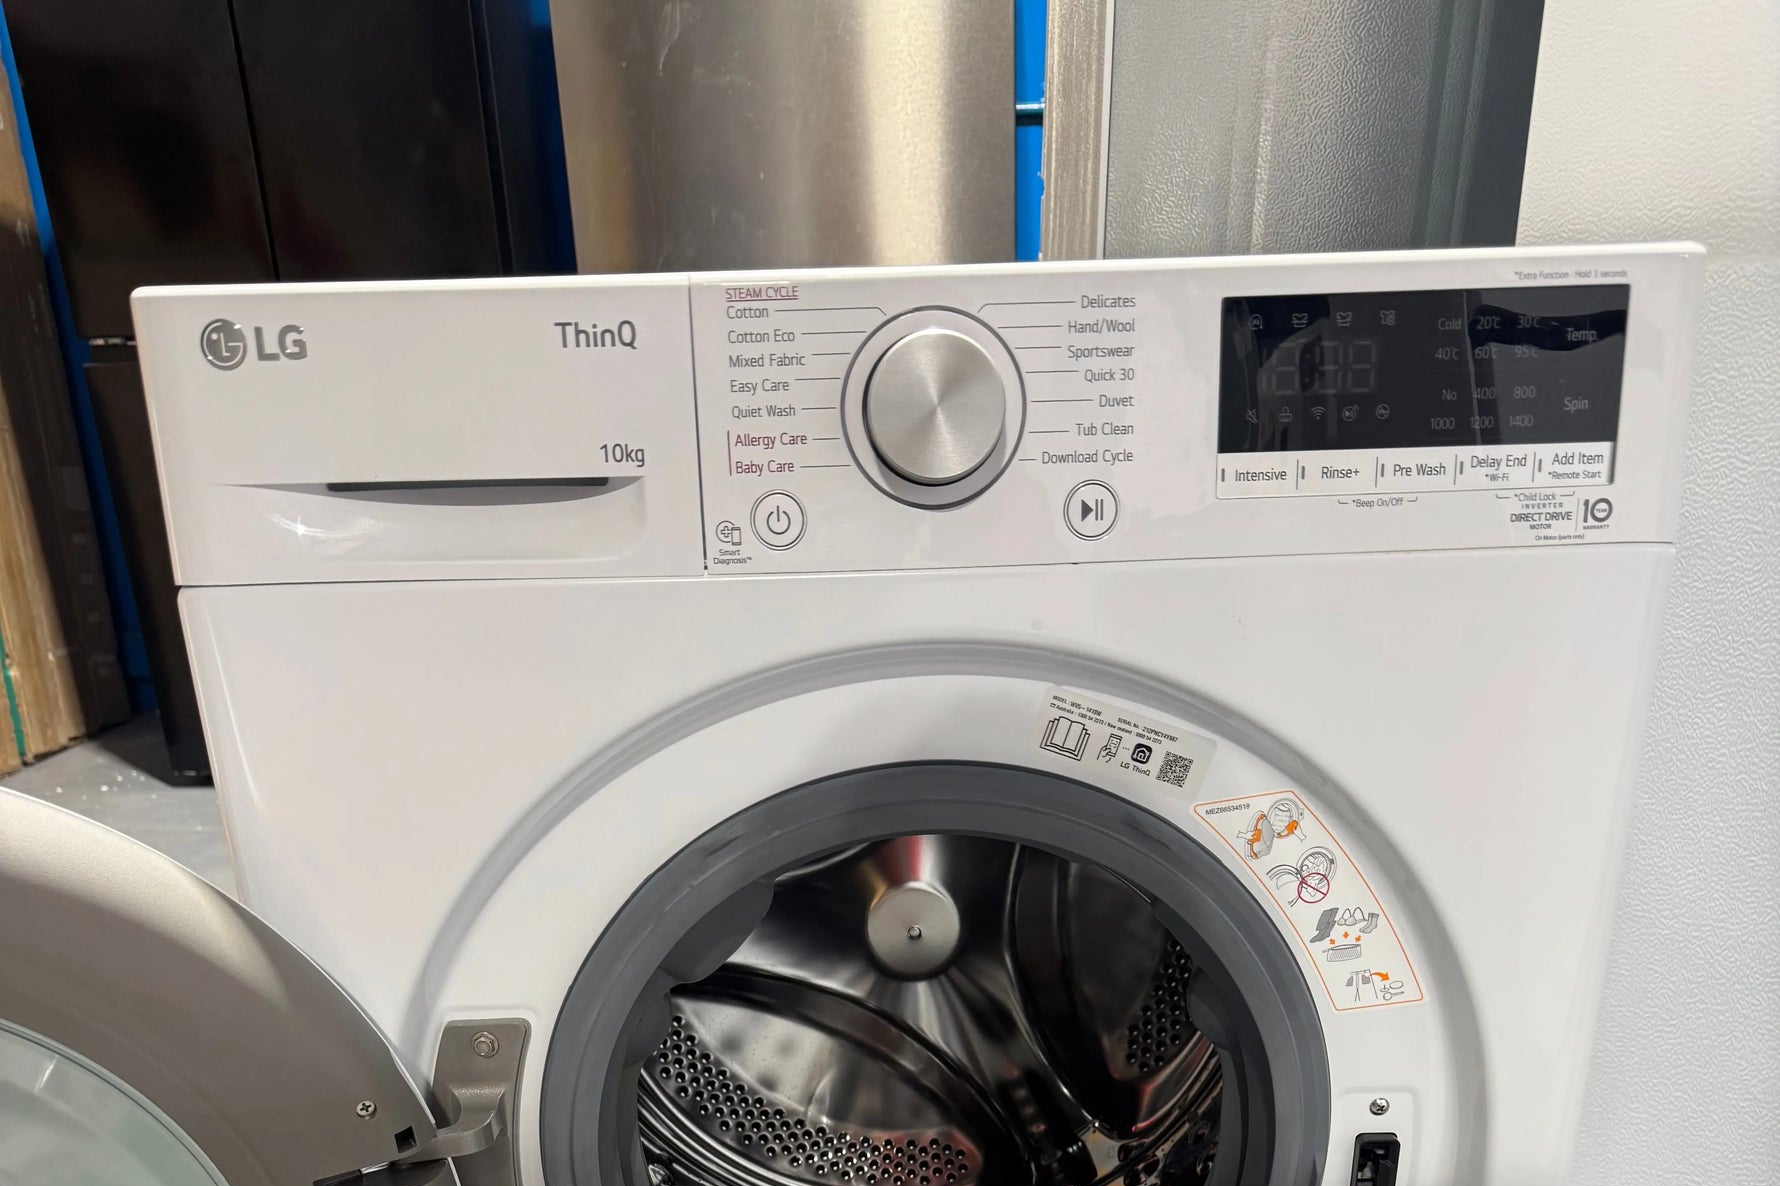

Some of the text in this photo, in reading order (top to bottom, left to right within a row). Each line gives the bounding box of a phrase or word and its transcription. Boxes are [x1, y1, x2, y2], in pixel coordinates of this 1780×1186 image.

[725, 286, 799, 299] STEAM CYCLE
[1081, 294, 1136, 309] Delicates
[726, 305, 769, 319] Cotton
[1068, 318, 1136, 334] Hand/Wool
[1438, 317, 1462, 331] Cold
[254, 324, 308, 361] LG
[553, 320, 638, 350] ThinQ
[728, 329, 796, 344] Cotton Eco
[1067, 344, 1135, 361] Sportswear
[729, 353, 806, 368] Mixed Fabric
[1084, 368, 1135, 383] Quick 30
[730, 378, 790, 396] Easy Care
[1442, 386, 1536, 401] No 400 800
[1099, 395, 1135, 408] Duvet
[1563, 397, 1589, 413] Spin
[732, 404, 796, 419] Quiet Wash
[1075, 422, 1134, 436] Tub Clean
[1430, 415, 1534, 430] 1000 1200 1400
[735, 432, 808, 449] Allergy Care
[600, 443, 645, 468] 10kg
[1042, 449, 1134, 466] Download Cycle
[1471, 453, 1528, 471] Delay End
[1552, 451, 1604, 466] Add Item
[735, 459, 795, 477] Baby Care
[1235, 468, 1287, 482] Intensive
[1321, 465, 1360, 480] Rinse+
[1393, 462, 1446, 477] Pre Wash
[1582, 470, 1602, 479] Start
[1376, 497, 1404, 508] On/Off
[1539, 491, 1557, 501] Lock
[1521, 502, 1564, 510] INVERTER
[1583, 497, 1613, 523] 10
[1510, 511, 1573, 523] DIRECT DRIVE
[718, 549, 741, 557] Smart
[1120, 761, 1151, 776] LG ThinQ
